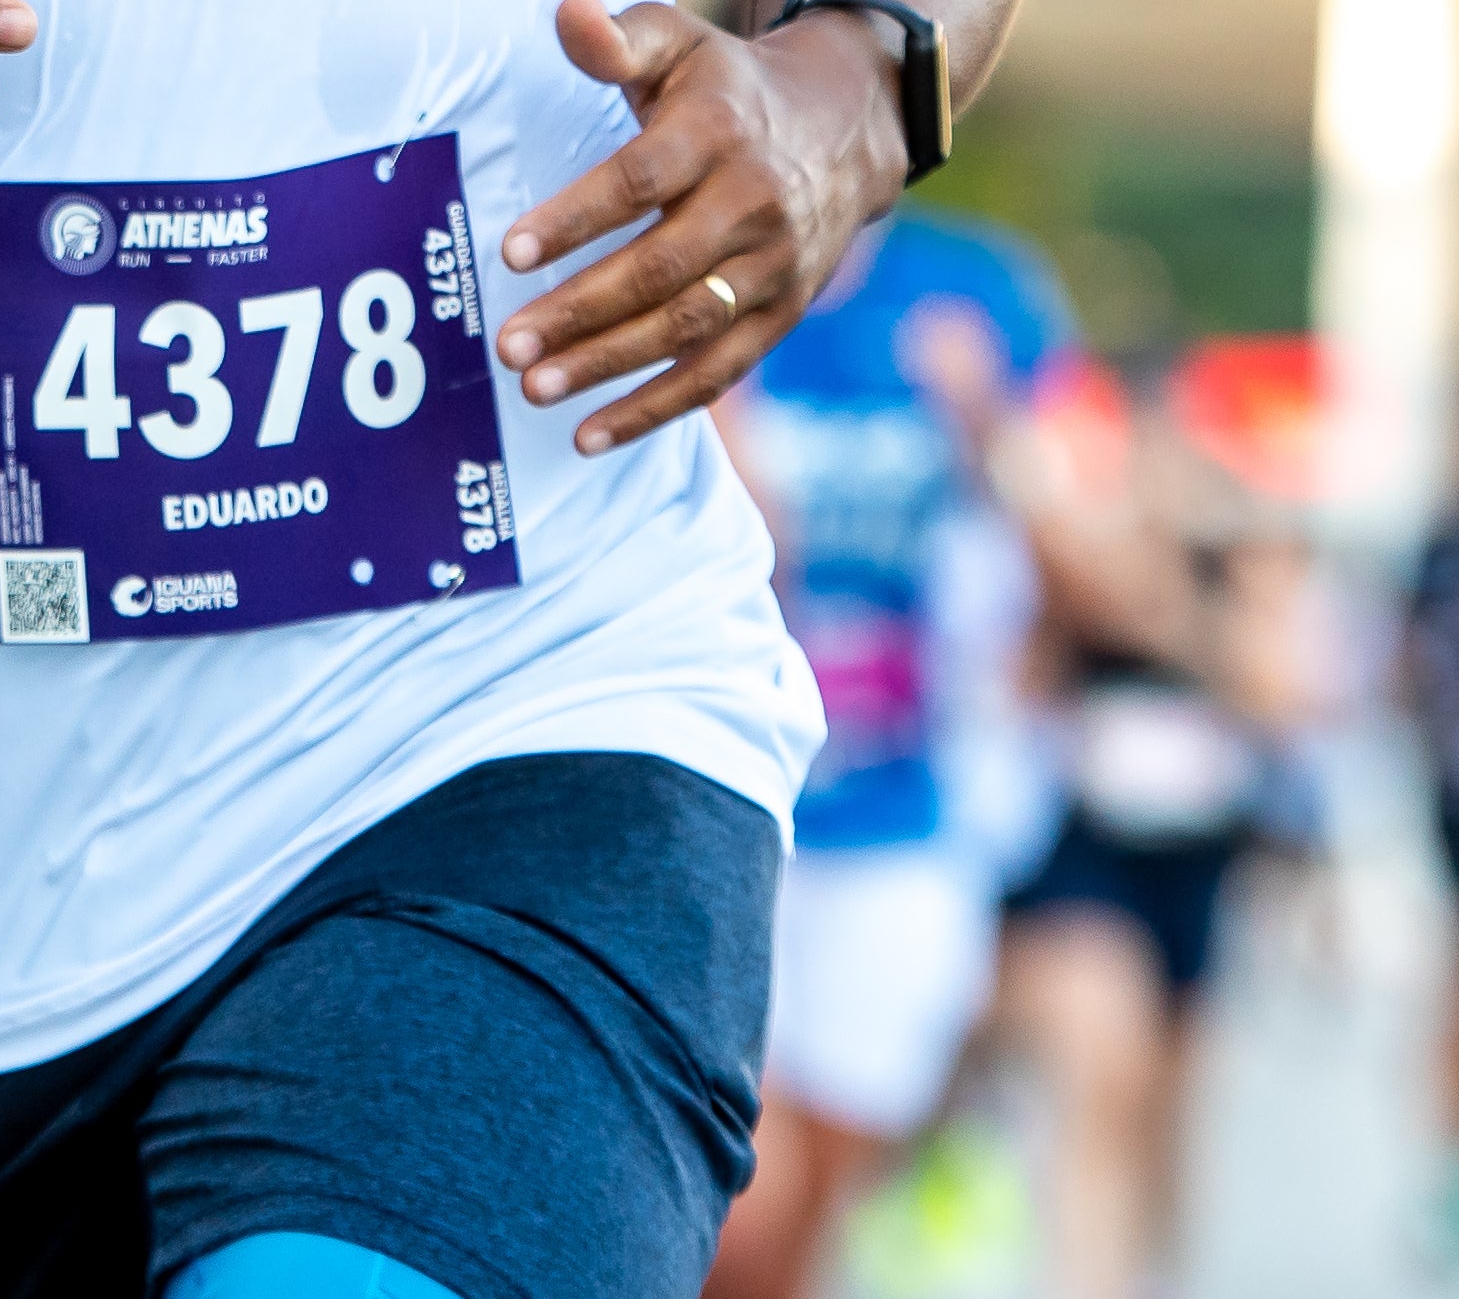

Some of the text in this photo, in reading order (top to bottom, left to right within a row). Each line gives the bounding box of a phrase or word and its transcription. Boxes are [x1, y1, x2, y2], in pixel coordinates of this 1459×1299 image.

[121, 205, 269, 249] ATHENAS
[118, 245, 269, 268] RUN FASTER
[422, 227, 463, 322] 4378
[32, 268, 427, 460] 4378
[161, 476, 329, 532] EDUARDO
[454, 459, 498, 554] 4378
[153, 590, 239, 614] SPORTS
